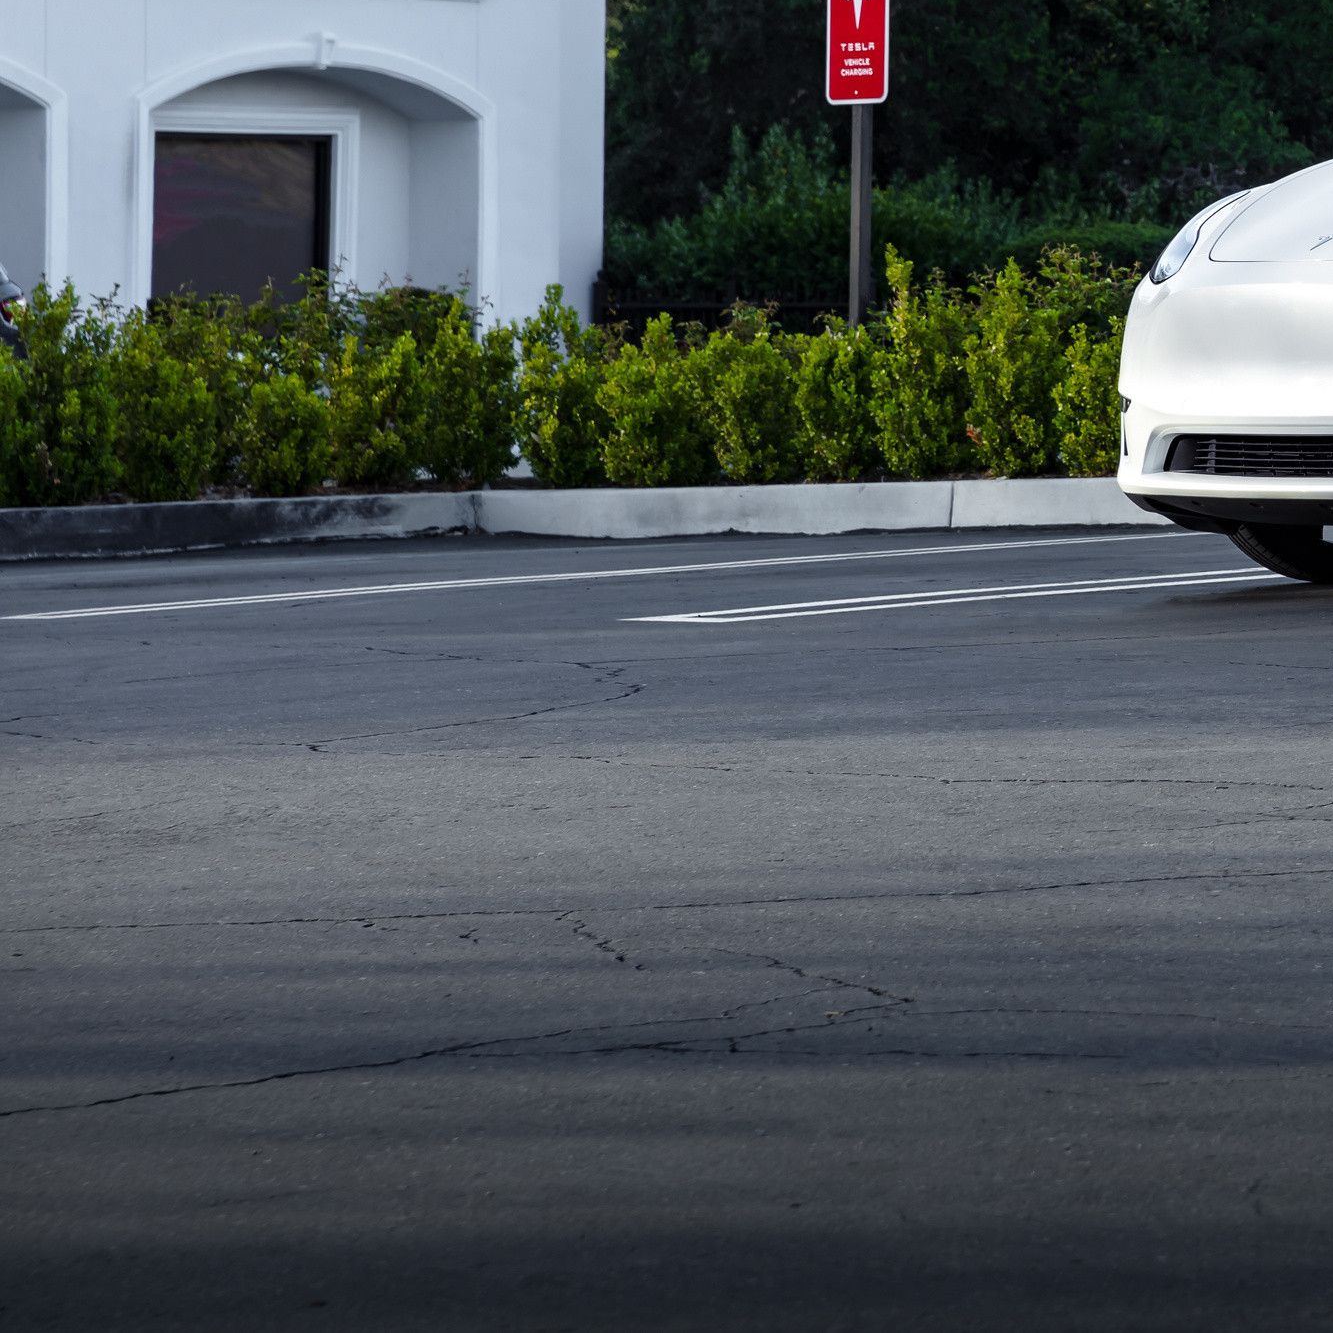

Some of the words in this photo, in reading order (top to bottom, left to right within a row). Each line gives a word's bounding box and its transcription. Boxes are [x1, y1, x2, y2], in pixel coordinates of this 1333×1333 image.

[840, 41, 875, 52] TESLA
[844, 57, 870, 67] VEHICLE
[840, 68, 873, 77] CHARGING
